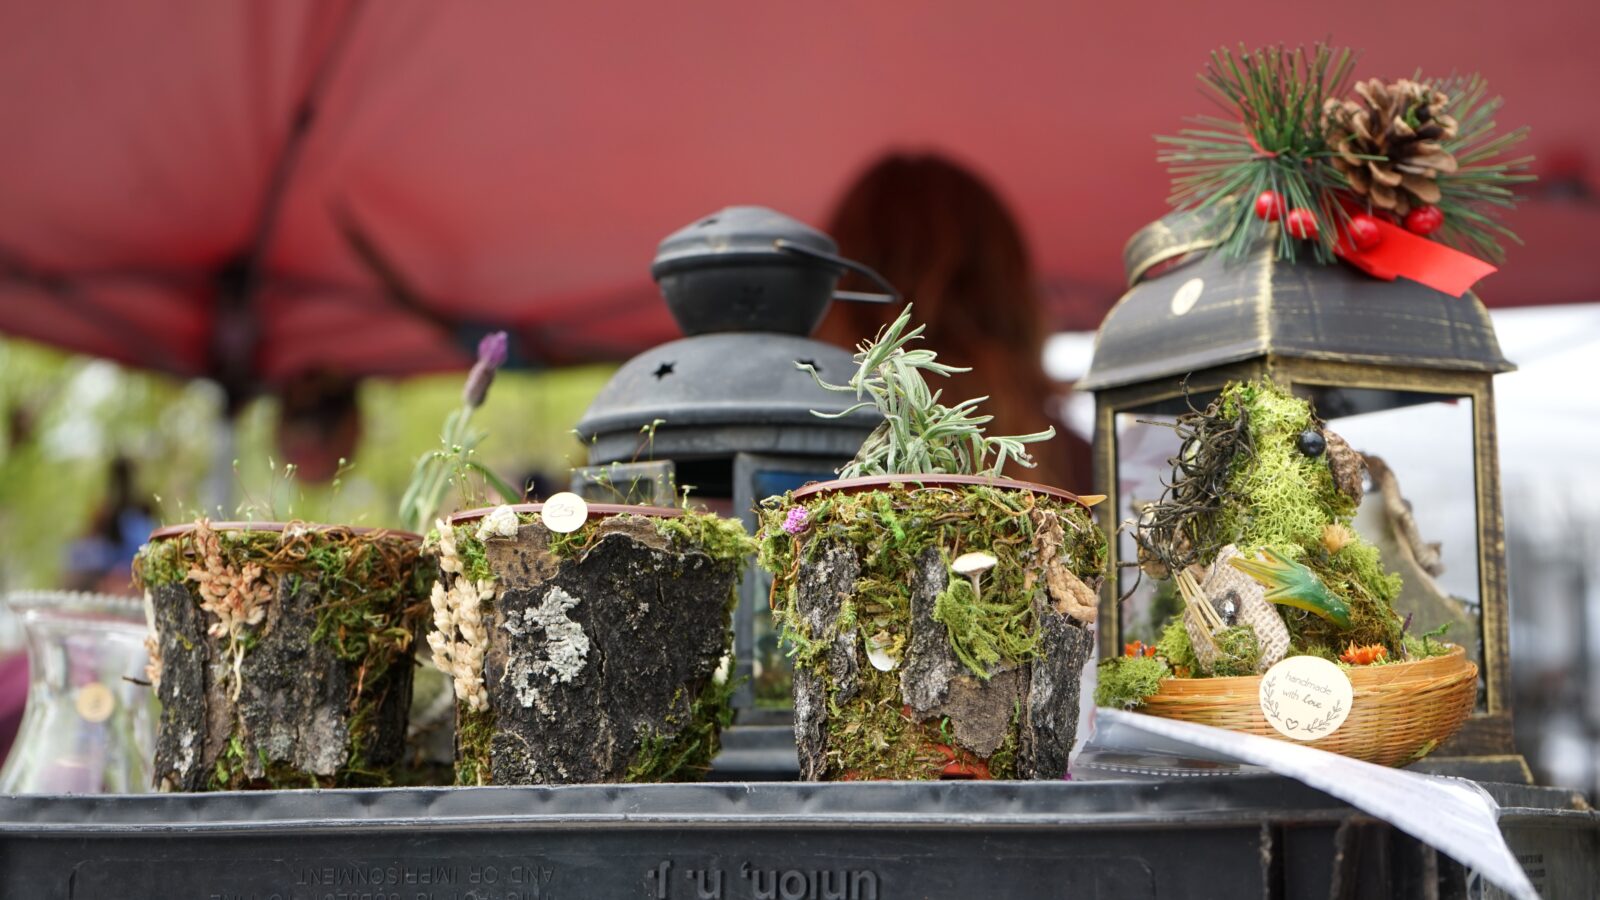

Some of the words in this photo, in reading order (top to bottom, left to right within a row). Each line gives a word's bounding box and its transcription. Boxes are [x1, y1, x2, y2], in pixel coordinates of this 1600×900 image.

[1285, 671, 1333, 695] handmade
[1282, 688, 1300, 701] with
[1302, 693, 1322, 709] love
[468, 865, 499, 884] OR
[510, 866, 554, 884] AND
